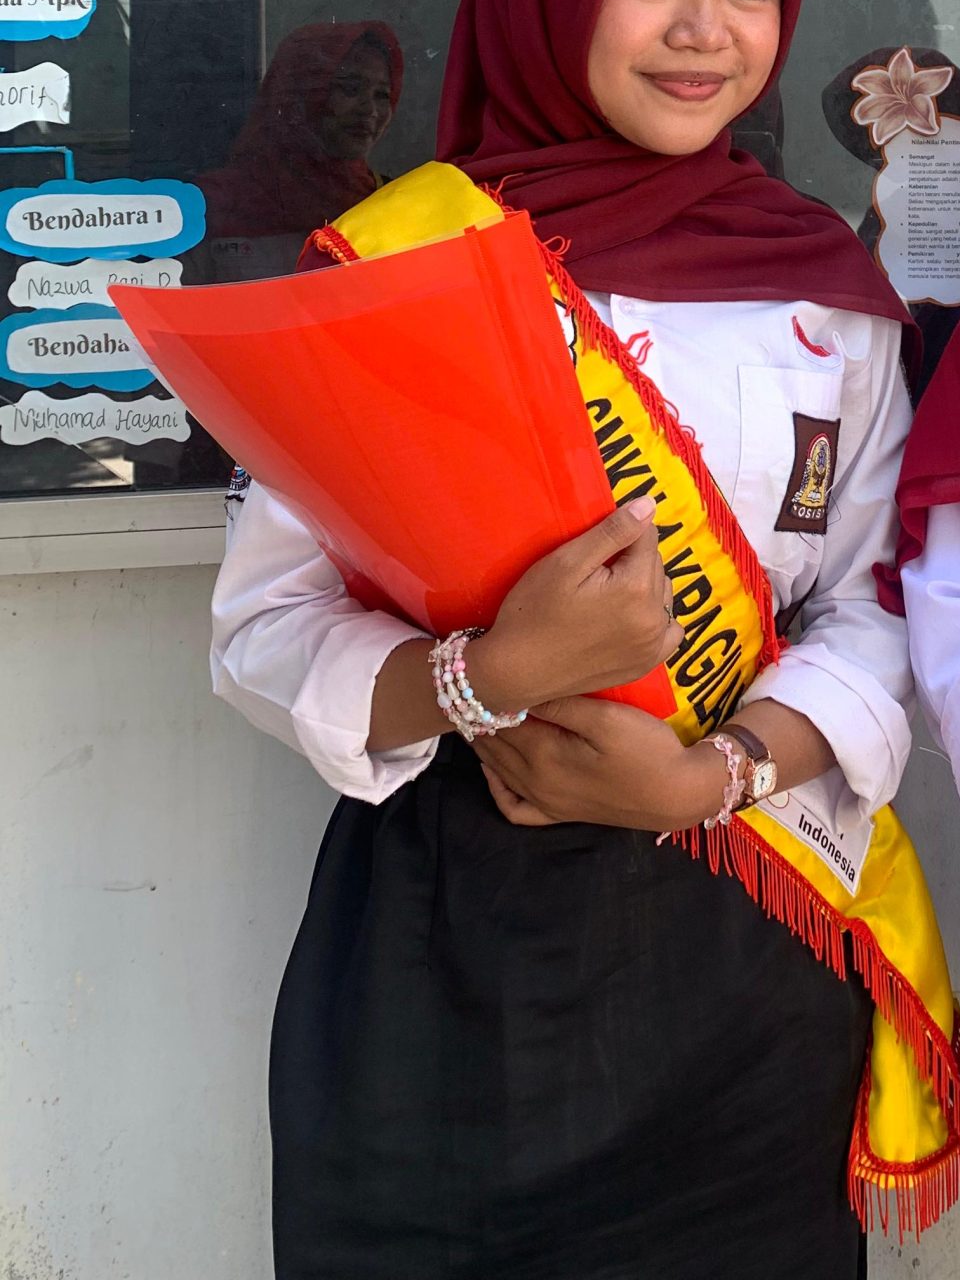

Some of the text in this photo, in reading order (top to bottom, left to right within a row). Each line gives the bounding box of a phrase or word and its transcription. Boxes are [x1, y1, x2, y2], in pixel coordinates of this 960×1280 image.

[23, 207, 148, 231] Bendahara
[28, 276, 93, 299] Nazwa
[28, 333, 130, 358] Bendaha
[14, 407, 178, 433] Muhamad Hayani
[798, 507, 825, 519] OSIS
[798, 814, 856, 883] Indonesia
